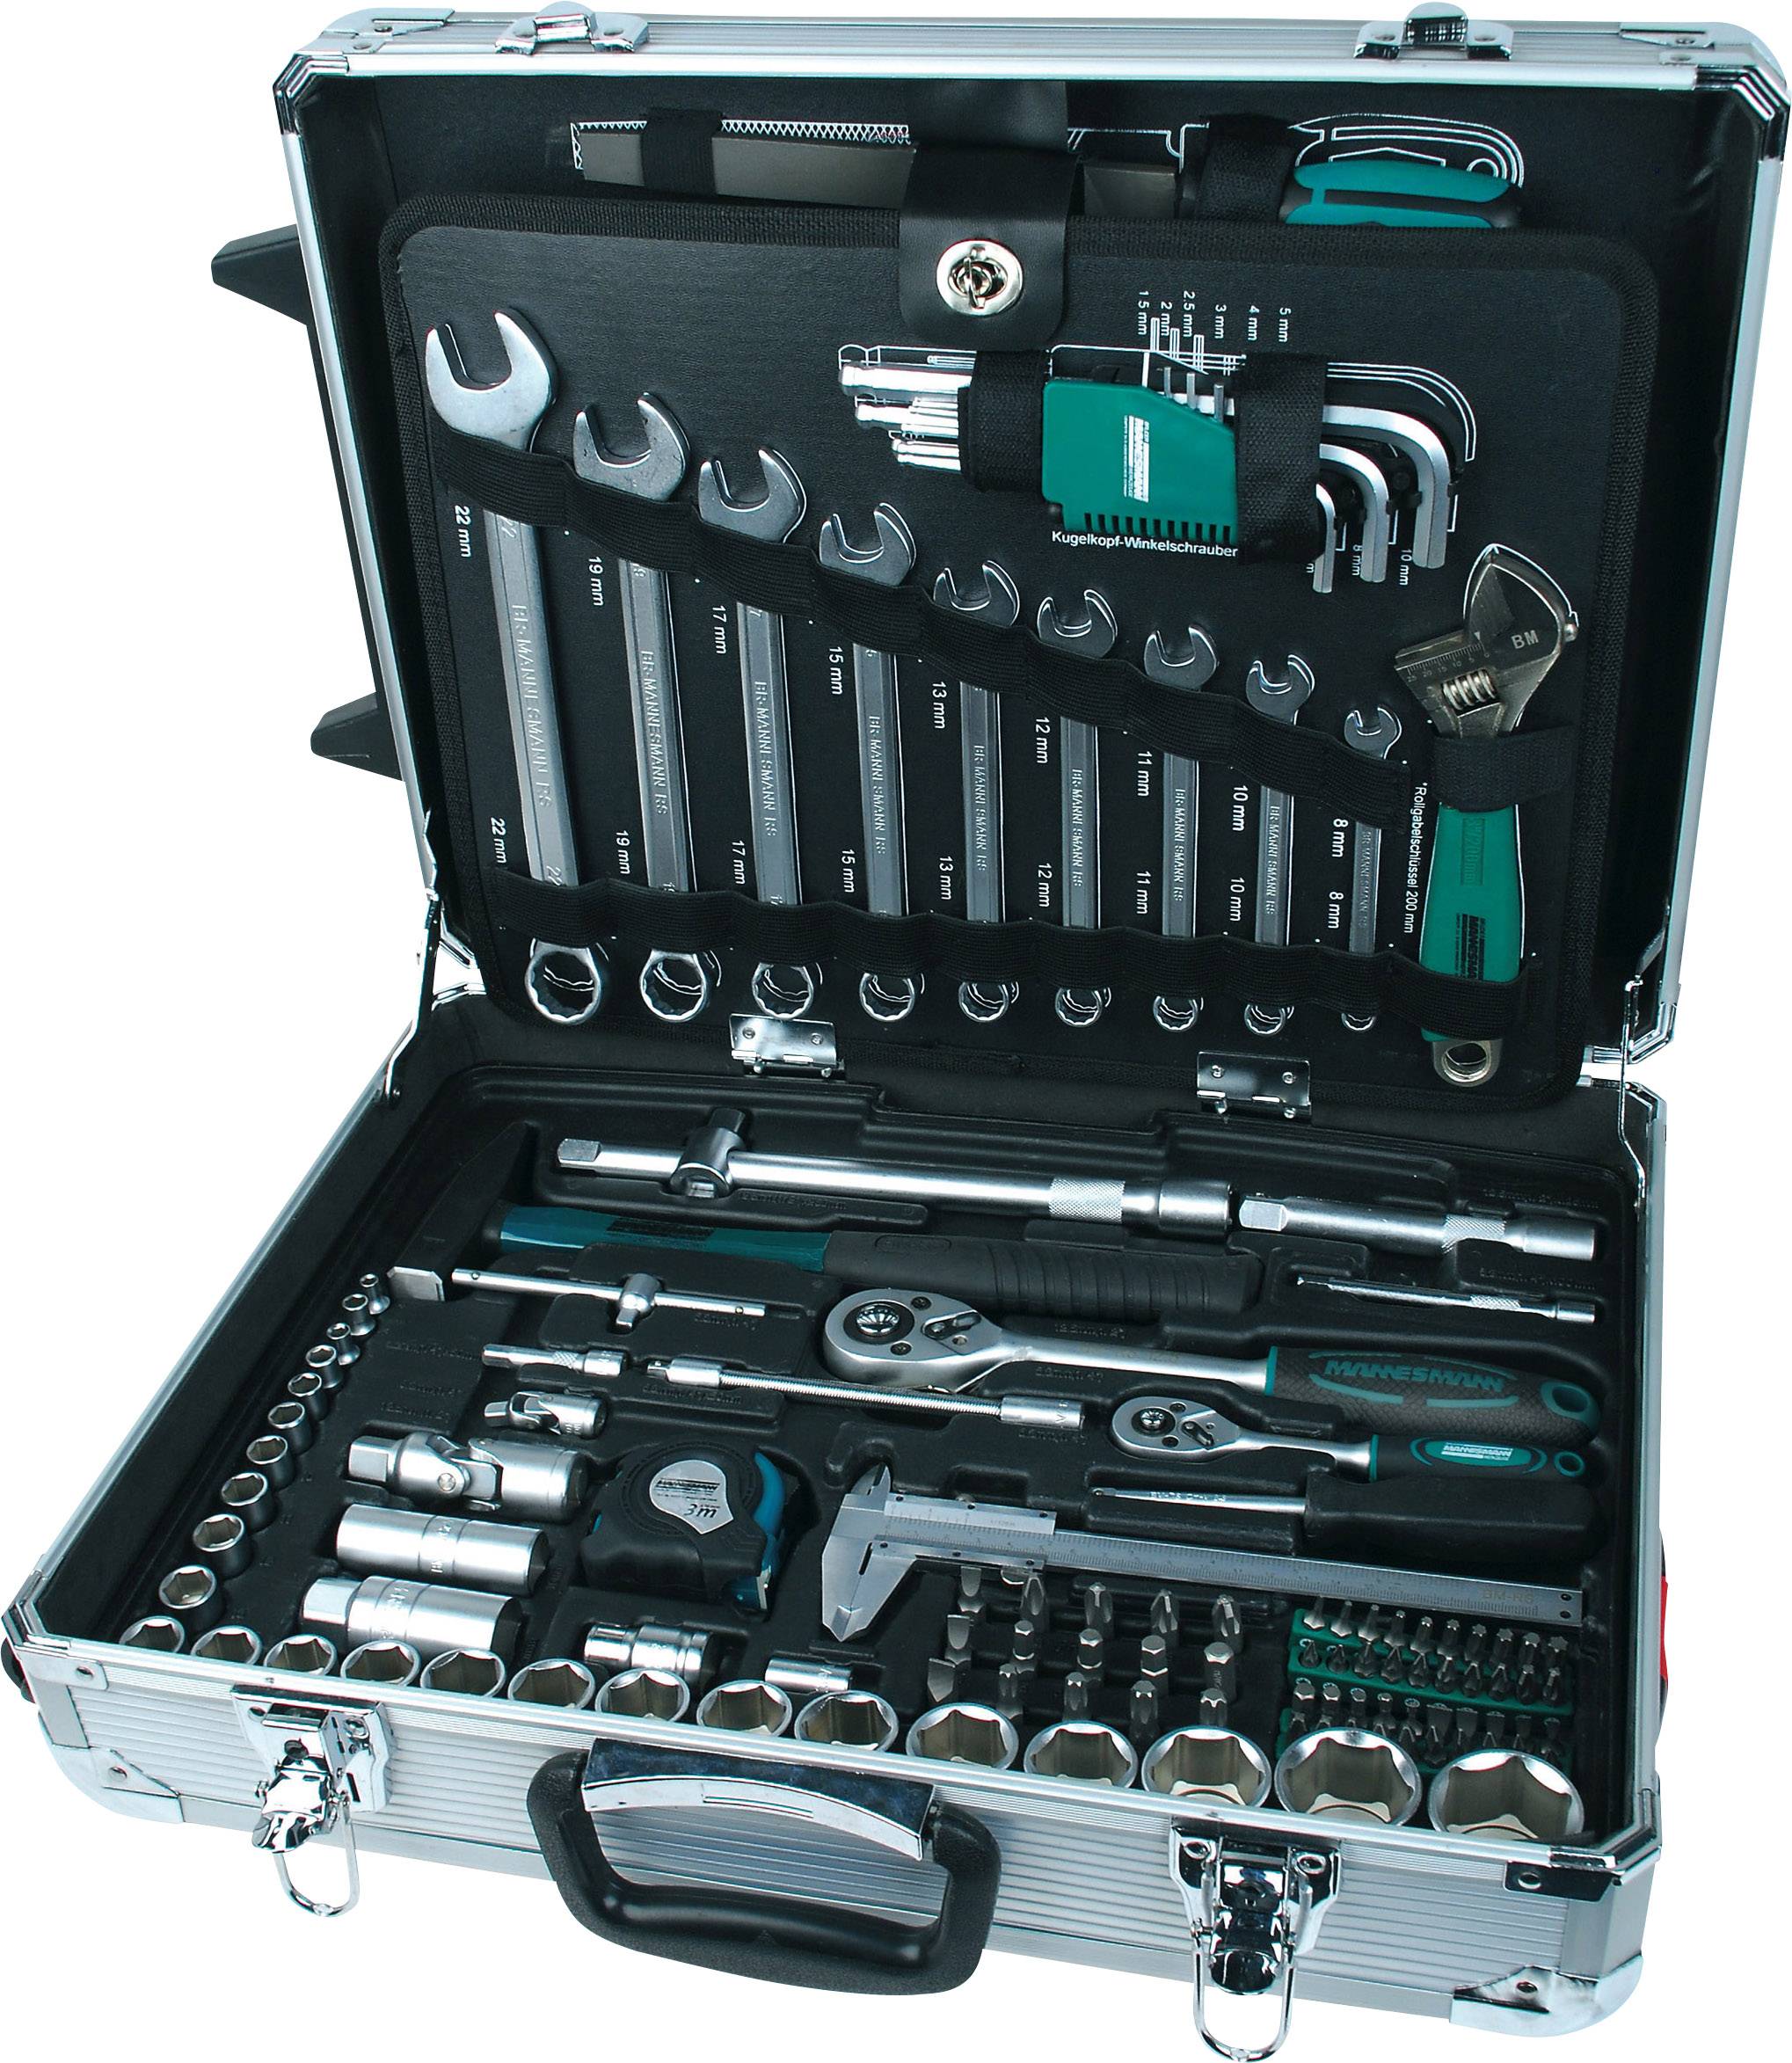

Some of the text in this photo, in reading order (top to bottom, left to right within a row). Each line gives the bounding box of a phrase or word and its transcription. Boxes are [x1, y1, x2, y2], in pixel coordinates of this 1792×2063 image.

[1138, 312, 1147, 335] mm
[1161, 313, 1170, 336] mm
[1184, 314, 1193, 338] mm
[1214, 316, 1225, 339] mm
[1248, 305, 1260, 341] 4 mm
[1278, 307, 1292, 343] 5 mm
[455, 505, 472, 558] 22 mm
[1052, 531, 1238, 558] Kugelkopf-Winkelschrauber
[588, 556, 605, 607] 19 mm
[1351, 555, 1360, 576] mm
[1399, 549, 1412, 586] 10 mm
[712, 605, 728, 654] 17 mm
[1511, 630, 1539, 650] BM
[828, 646, 844, 696] 15 mm
[932, 681, 948, 729] 13 mm
[1035, 717, 1051, 765] 12 mm
[1137, 751, 1153, 797] 11 mm
[1232, 784, 1249, 832] 10 mm
[491, 817, 507, 864] 22 mm
[616, 829, 631, 875] 19 mm
[1331, 818, 1349, 858] 8 mm
[1403, 786, 1427, 934] Rollgabelschlüssel 200 mm
[731, 840, 746, 885] 17 mm
[841, 849, 856, 893] 15 mm
[939, 856, 954, 900] 13 mm
[1038, 863, 1053, 908] 12 mm
[1136, 871, 1151, 915] 11 mm
[1229, 877, 1245, 922] 10 mm
[1328, 891, 1344, 929] 8 mm
